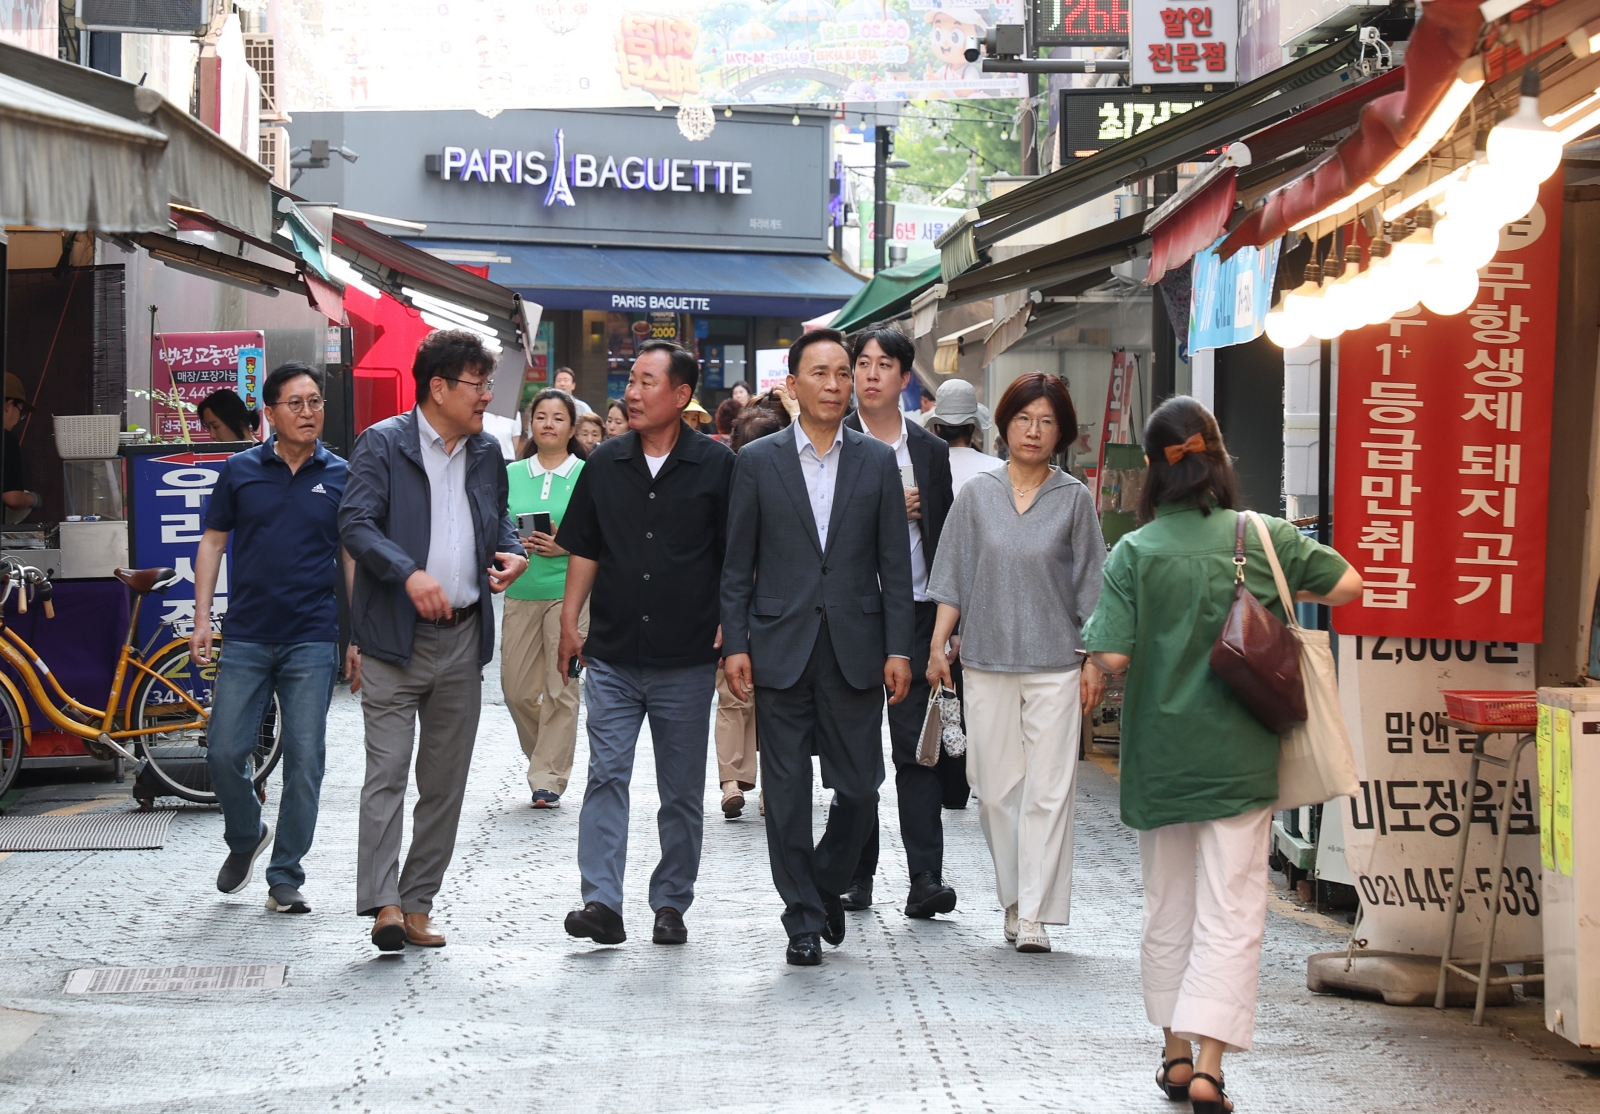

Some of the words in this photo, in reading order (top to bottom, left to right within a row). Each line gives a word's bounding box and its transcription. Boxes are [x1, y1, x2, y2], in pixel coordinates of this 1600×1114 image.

[1160, 7, 1212, 38] 할인
[1148, 41, 1226, 73] 전문점
[441, 146, 547, 186] PARIS
[572, 153, 753, 195] BAGUETTE
[867, 222, 916, 240] 26년
[611, 294, 647, 309] PARIS
[649, 295, 711, 311] BAGUETTE
[652, 327, 676, 338] 2000
[1462, 261, 1531, 432] 무항생제
[158, 346, 194, 366] 백년
[177, 369, 238, 383] 매장/포장가능
[245, 356, 257, 409] 콩국수
[1453, 444, 1521, 614] 돼지고기
[1350, 779, 1536, 837] 미도정육점
[1359, 866, 1543, 917] 02)445-533
